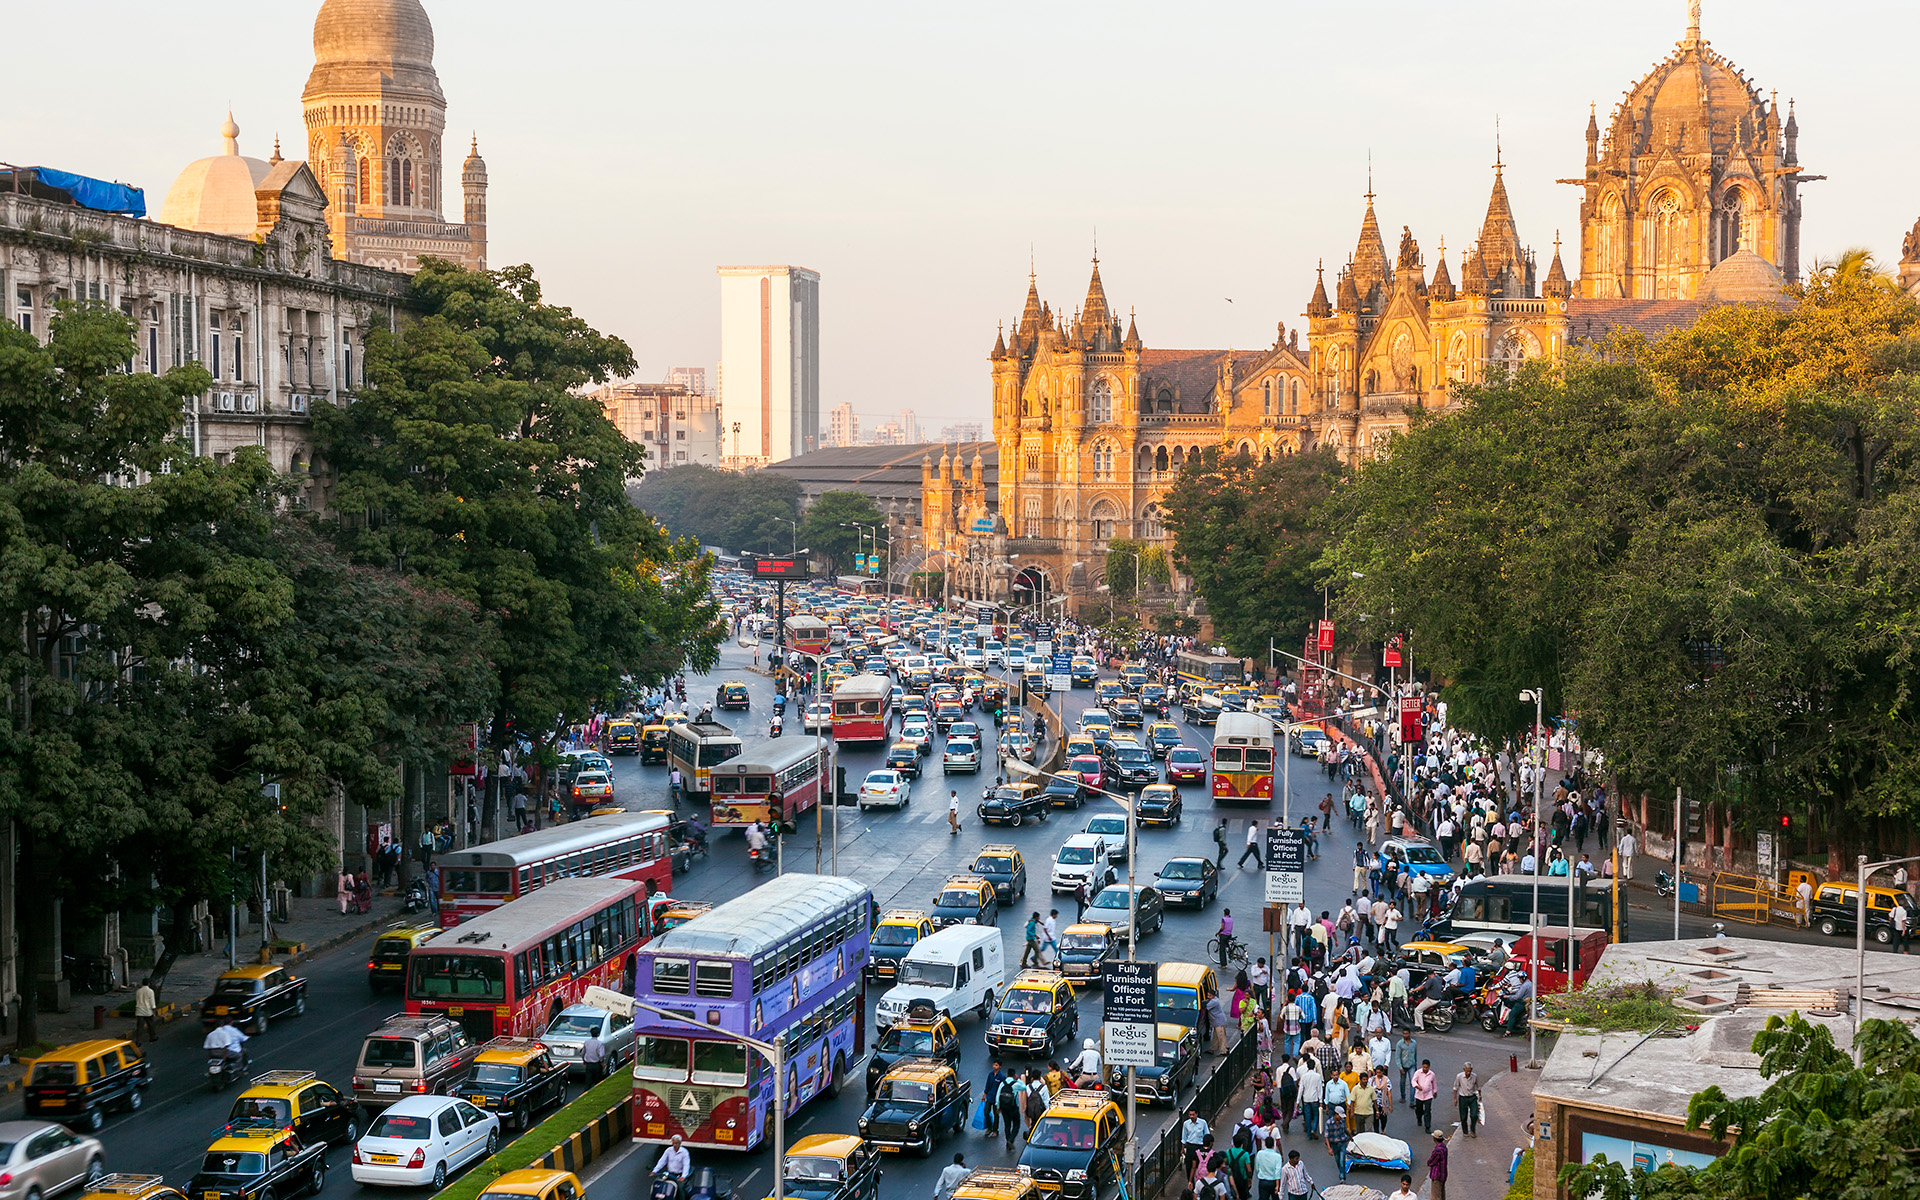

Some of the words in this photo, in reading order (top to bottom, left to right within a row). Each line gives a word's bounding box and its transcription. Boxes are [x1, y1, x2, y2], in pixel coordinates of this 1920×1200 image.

[1402, 699, 1420, 708] BETTER
[1272, 876, 1297, 884] Regus
[1119, 965, 1140, 974] Fully
[1106, 974, 1152, 984] Furnished
[1113, 985, 1146, 994] Offices
[1126, 996, 1144, 1004] Fort
[1112, 1028, 1147, 1040] Regus
